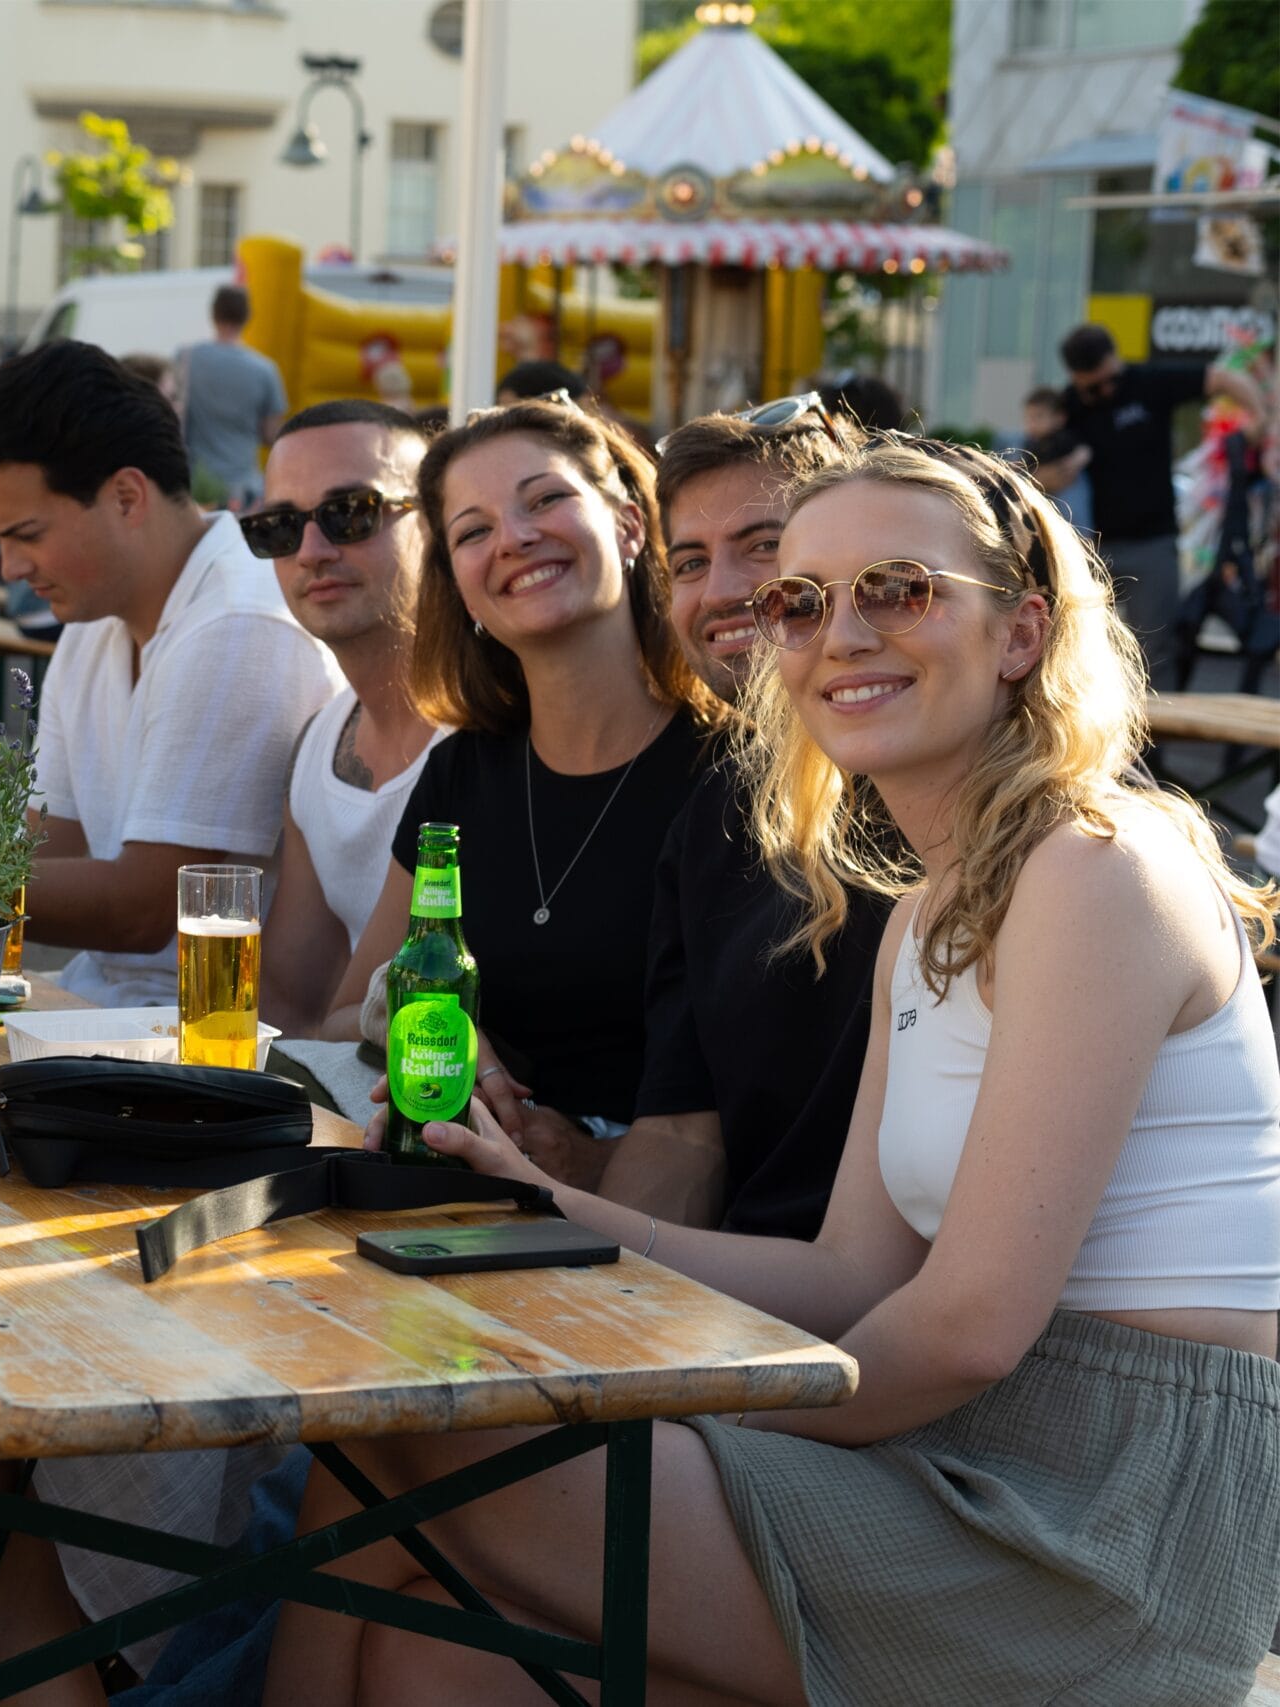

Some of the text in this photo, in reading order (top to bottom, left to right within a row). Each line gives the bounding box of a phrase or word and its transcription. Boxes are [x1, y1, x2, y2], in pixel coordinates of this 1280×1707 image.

[418, 895, 457, 906] Radler
[407, 1032, 458, 1047] Reissdorf
[410, 1048, 456, 1061] Kölner
[401, 1058, 464, 1077] Radler
